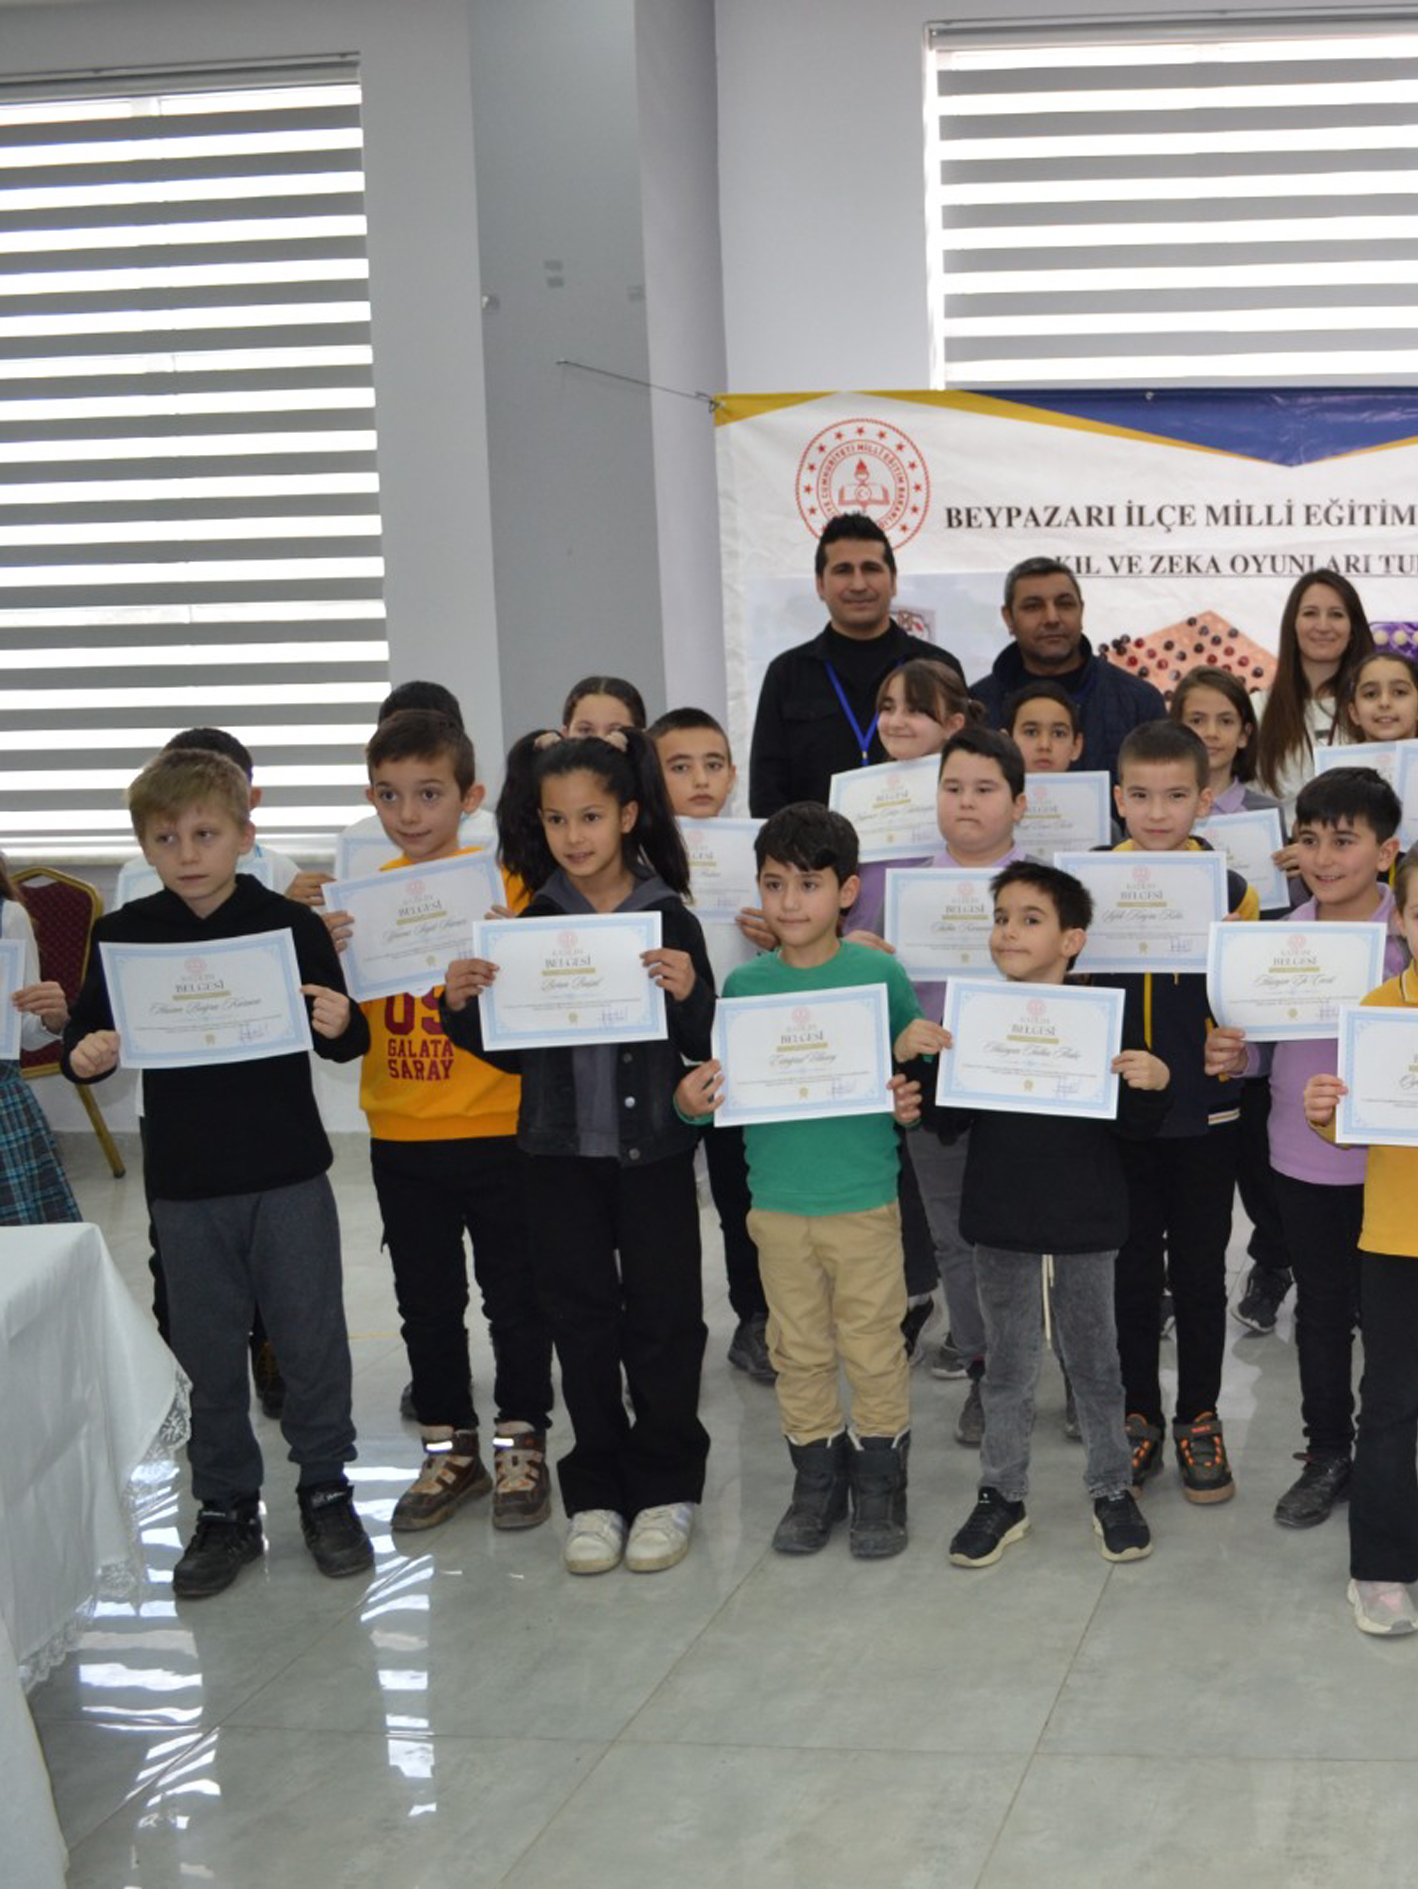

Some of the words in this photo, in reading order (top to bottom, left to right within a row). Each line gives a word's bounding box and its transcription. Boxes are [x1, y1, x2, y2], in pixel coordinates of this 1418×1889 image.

[945, 505, 1116, 529] BEYPAZARI
[1125, 500, 1197, 533] İLÇE
[1205, 499, 1294, 528] MİLLİ
[1304, 498, 1417, 527] EĞİTİM
[1054, 555, 1100, 574] KIL
[1109, 554, 1143, 574] VE
[1150, 554, 1223, 574] ZEKA
[1230, 554, 1371, 575] OYUNLARI
[387, 1038, 454, 1058] GALATA
[388, 1059, 454, 1081] SARAY
